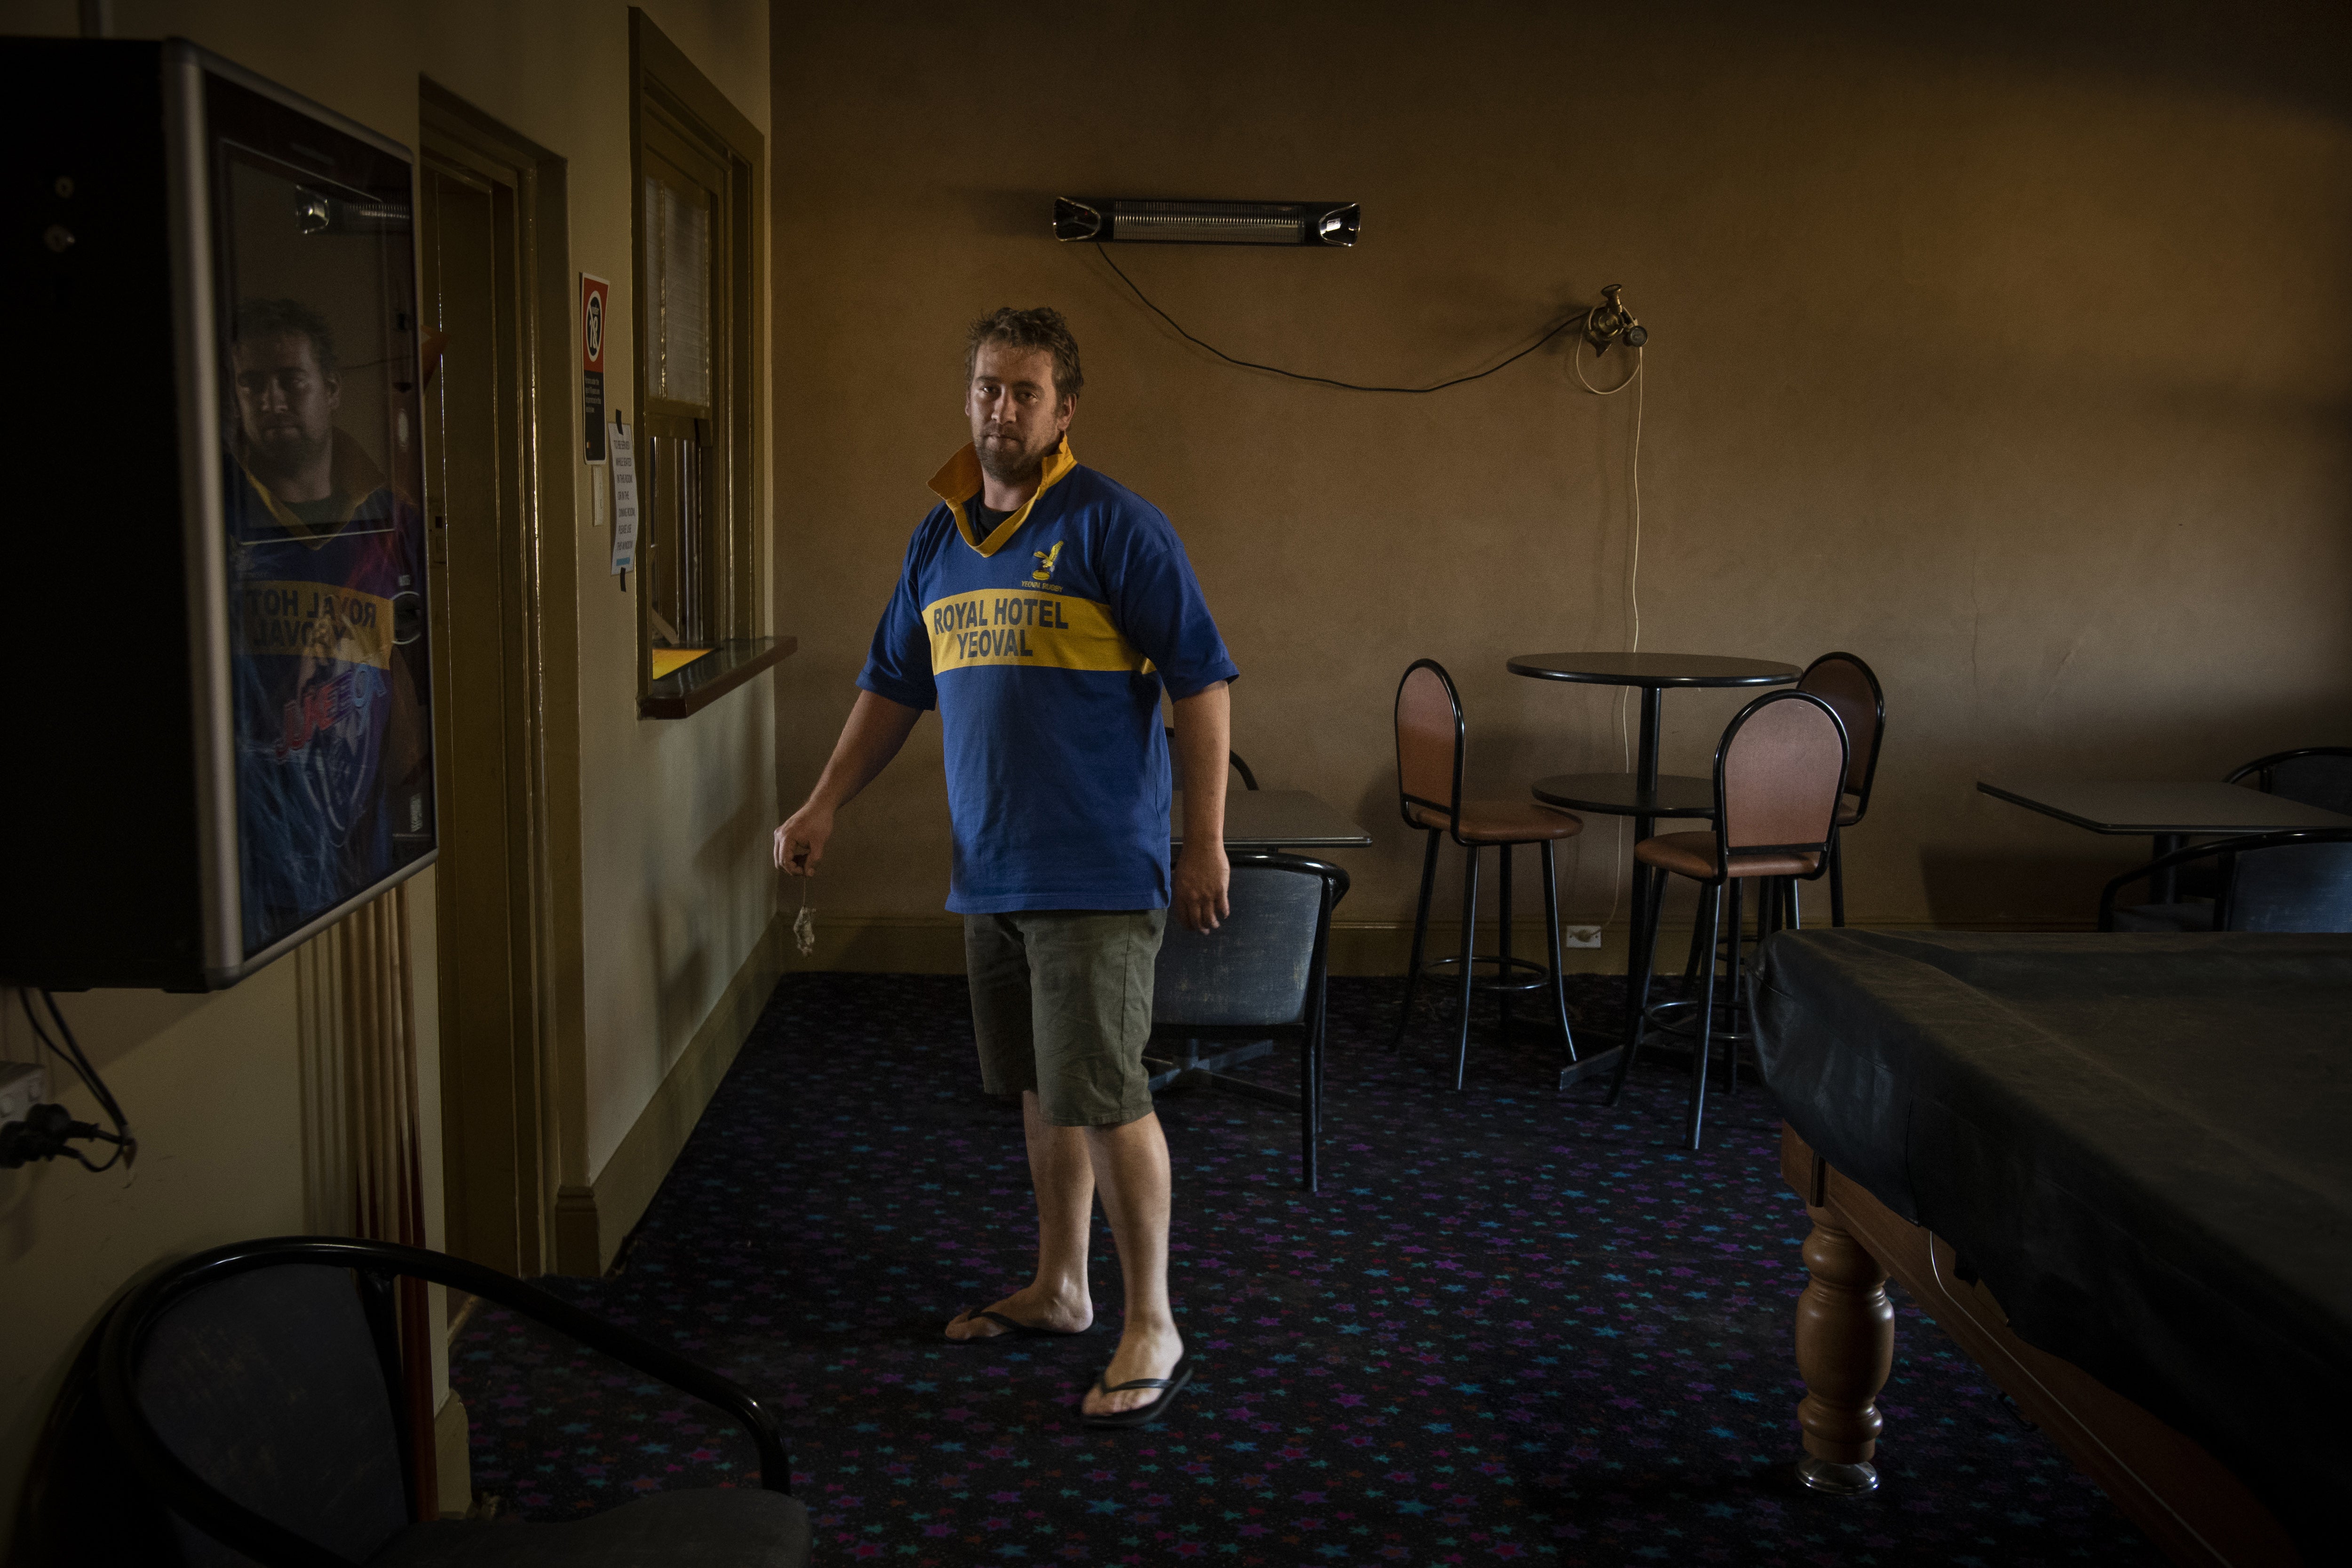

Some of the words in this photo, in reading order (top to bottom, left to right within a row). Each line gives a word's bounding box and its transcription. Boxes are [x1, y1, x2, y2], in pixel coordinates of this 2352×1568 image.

[589, 316, 598, 349] 18
[1042, 582, 1063, 593] RUGBY
[934, 599, 988, 635] ROYAL
[993, 597, 1069, 629] HOTEL
[956, 629, 1033, 660] YEOVAL
